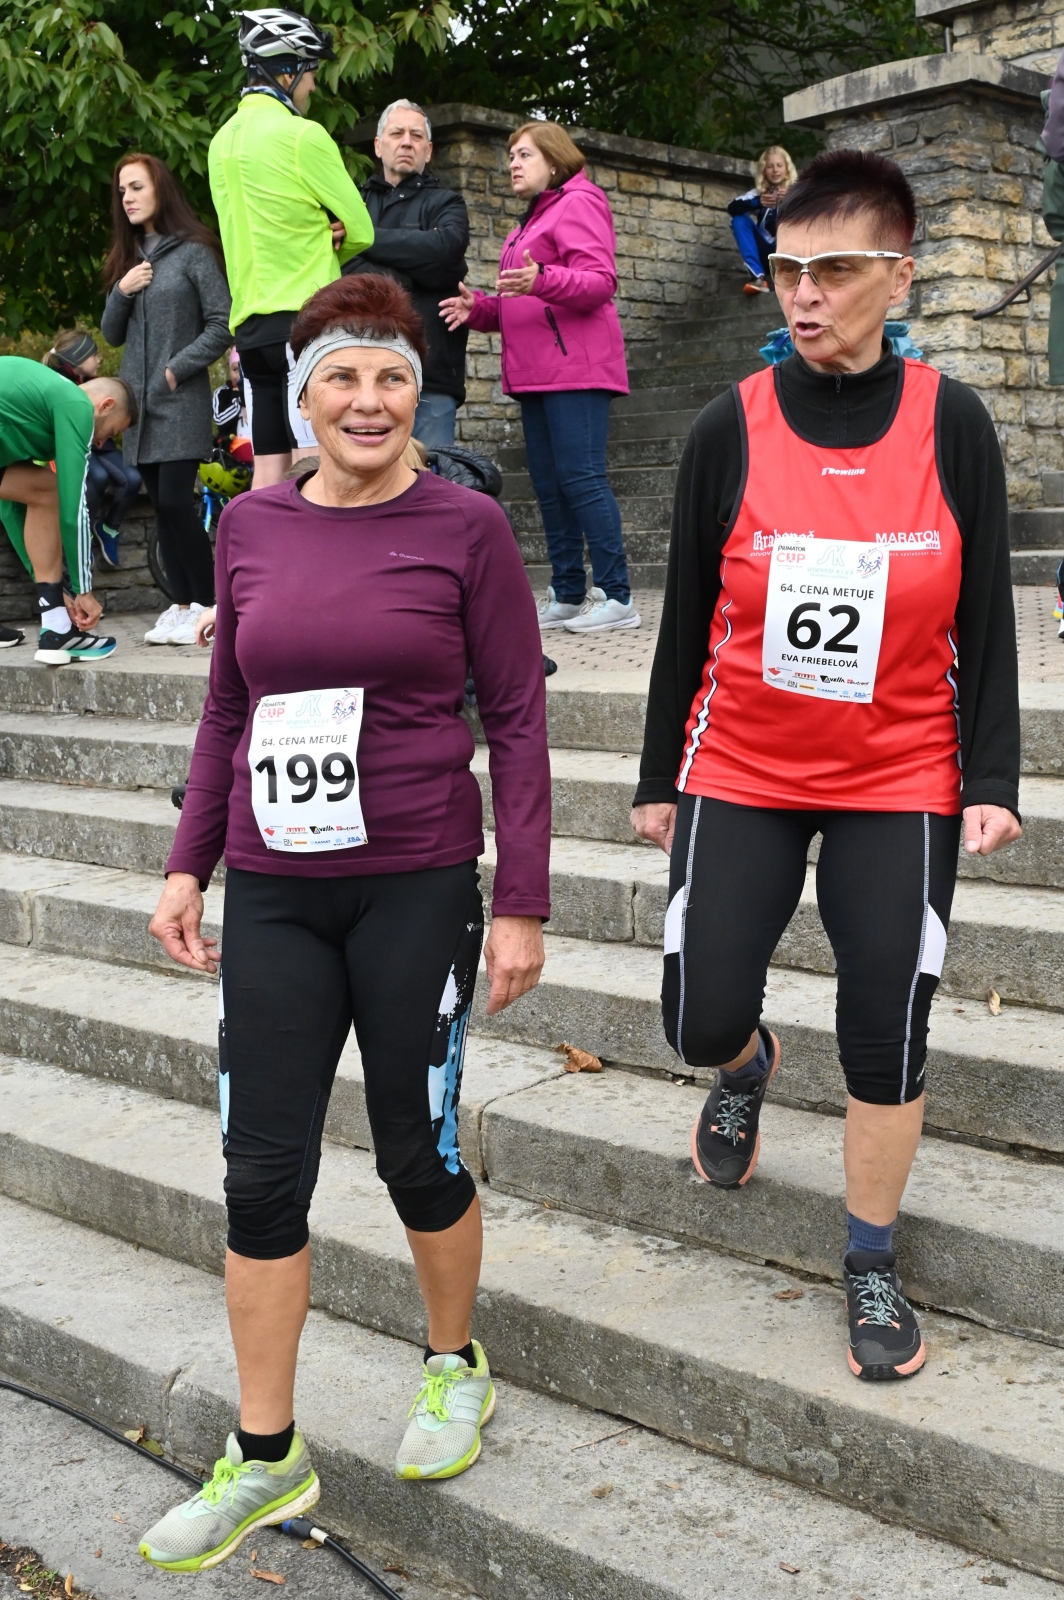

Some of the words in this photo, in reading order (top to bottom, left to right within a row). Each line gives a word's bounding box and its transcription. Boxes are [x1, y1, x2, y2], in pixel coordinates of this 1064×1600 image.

[875, 530, 940, 543] MARATON
[777, 544, 806, 552] PRIMATOR
[776, 552, 806, 564] CUP
[780, 583, 796, 593] 64.
[799, 584, 829, 595] CENA
[832, 587, 875, 601] METUJE
[787, 602, 861, 653] 62
[781, 653, 799, 663] EVA
[801, 655, 859, 669] FRIEBELOVÁ
[258, 707, 285, 719] CUP
[261, 738, 276, 746] 64.
[278, 736, 306, 746] CENA
[308, 734, 348, 745] METUJE
[254, 752, 356, 803] 199
